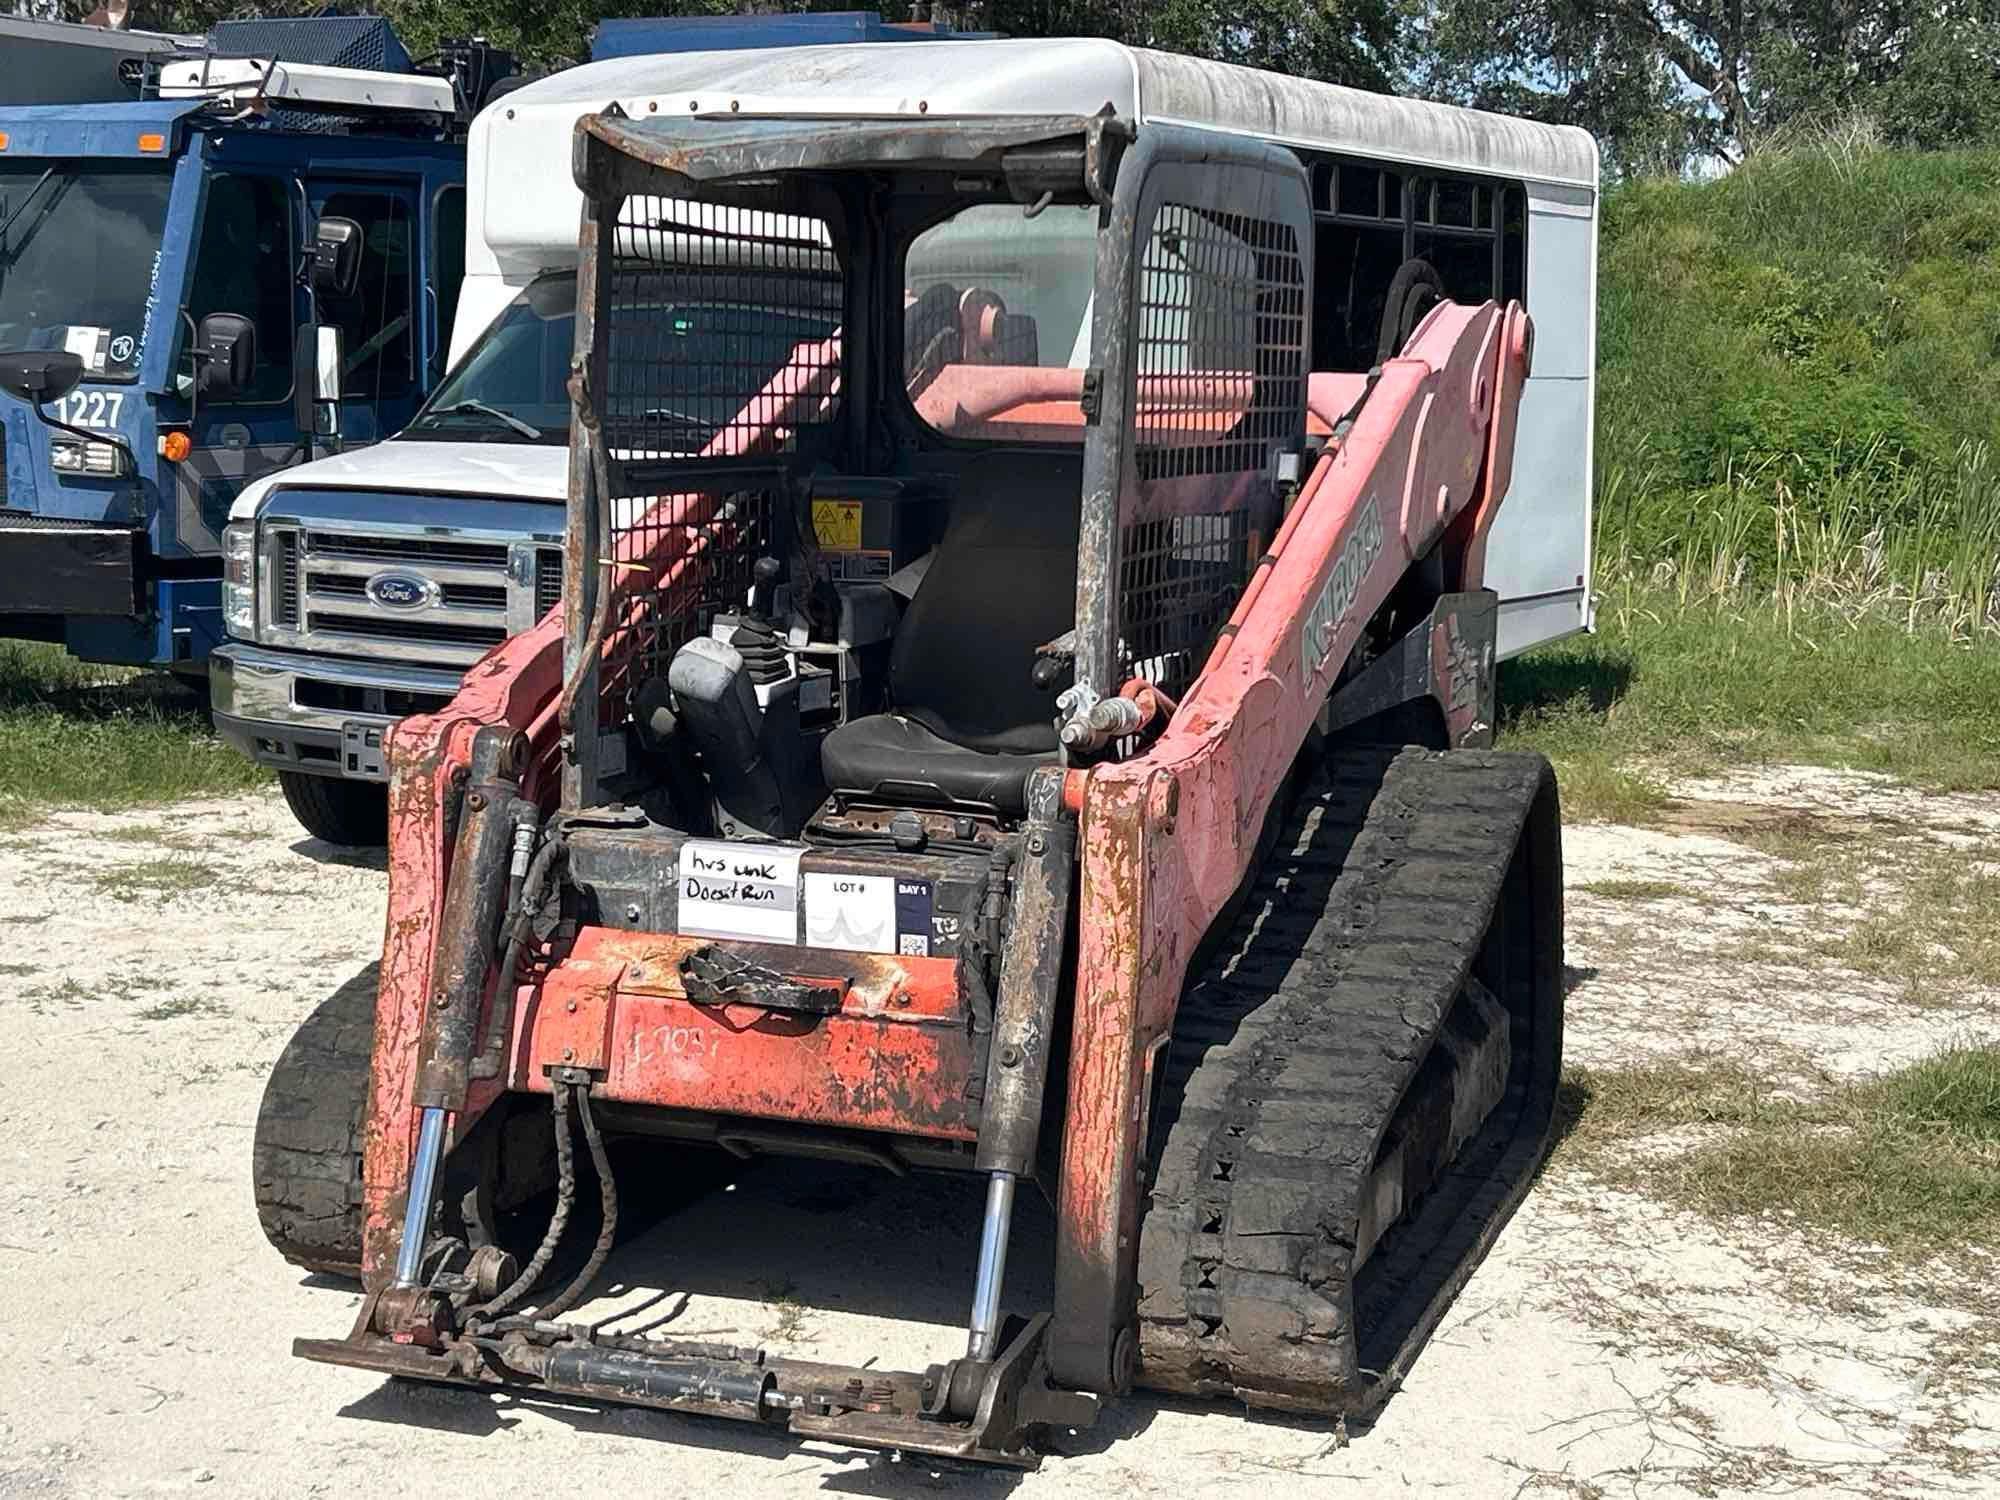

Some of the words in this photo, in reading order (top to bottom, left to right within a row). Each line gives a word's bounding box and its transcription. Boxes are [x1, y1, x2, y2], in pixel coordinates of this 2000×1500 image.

[54, 391, 124, 427] 1227
[380, 582, 413, 600] Ford
[834, 882, 856, 892] LOT
[899, 884, 919, 895] DAY
[920, 886, 927, 895] 1
